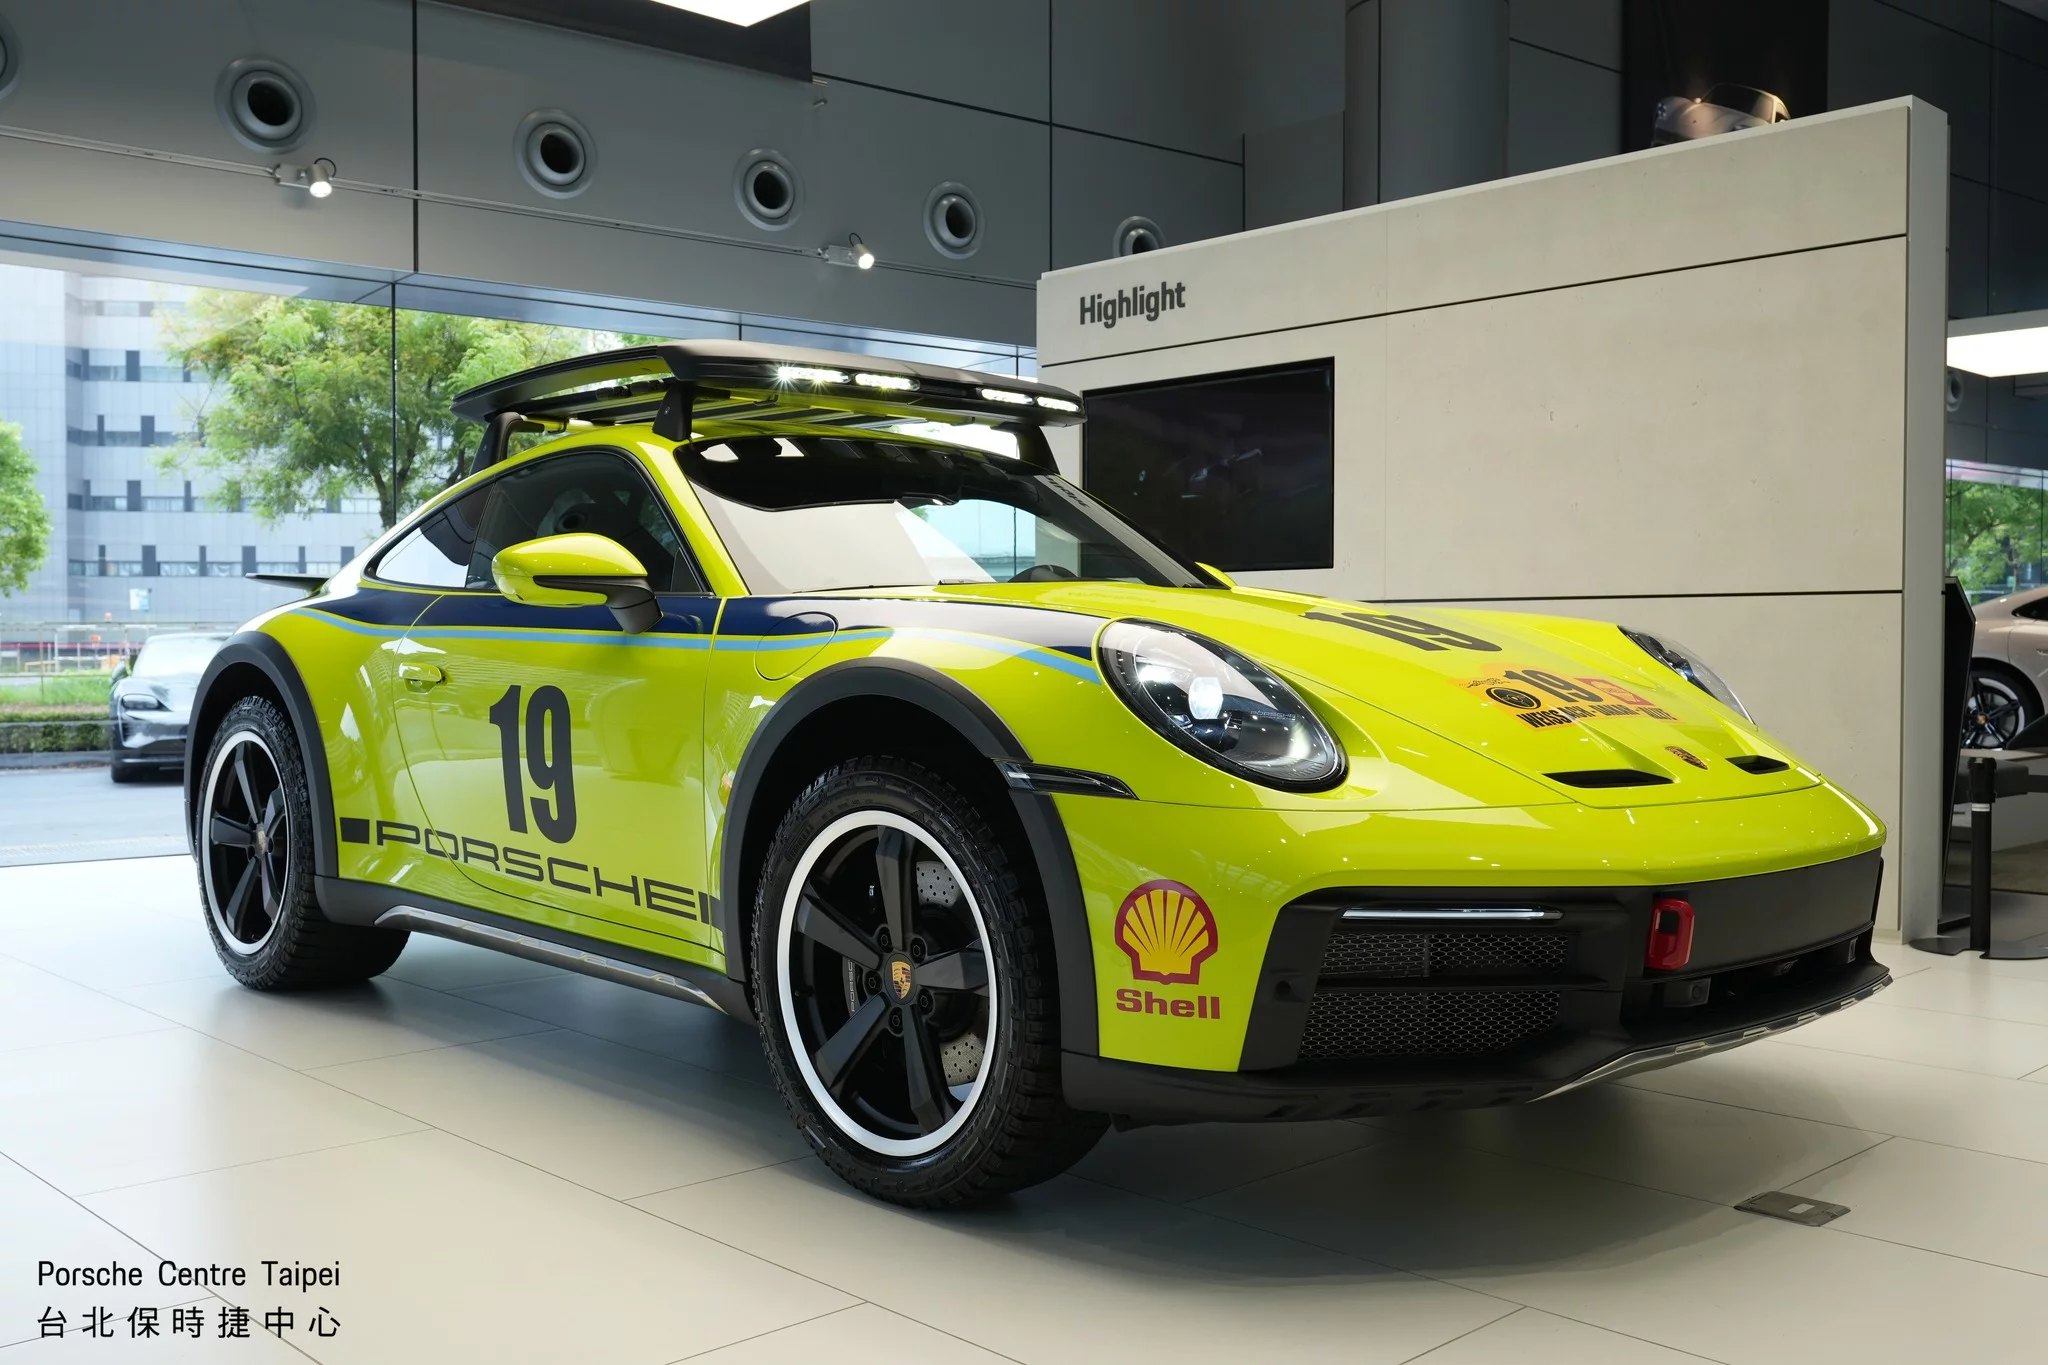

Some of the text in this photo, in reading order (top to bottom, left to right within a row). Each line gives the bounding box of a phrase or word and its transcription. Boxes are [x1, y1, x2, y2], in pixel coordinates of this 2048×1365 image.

[1080, 281, 1186, 329] Highlight
[1298, 611, 1503, 652] 19
[1503, 669, 1604, 703] 19
[489, 685, 577, 844] 19
[376, 820, 697, 921] PORSCHE
[1116, 988, 1221, 1019] Shell
